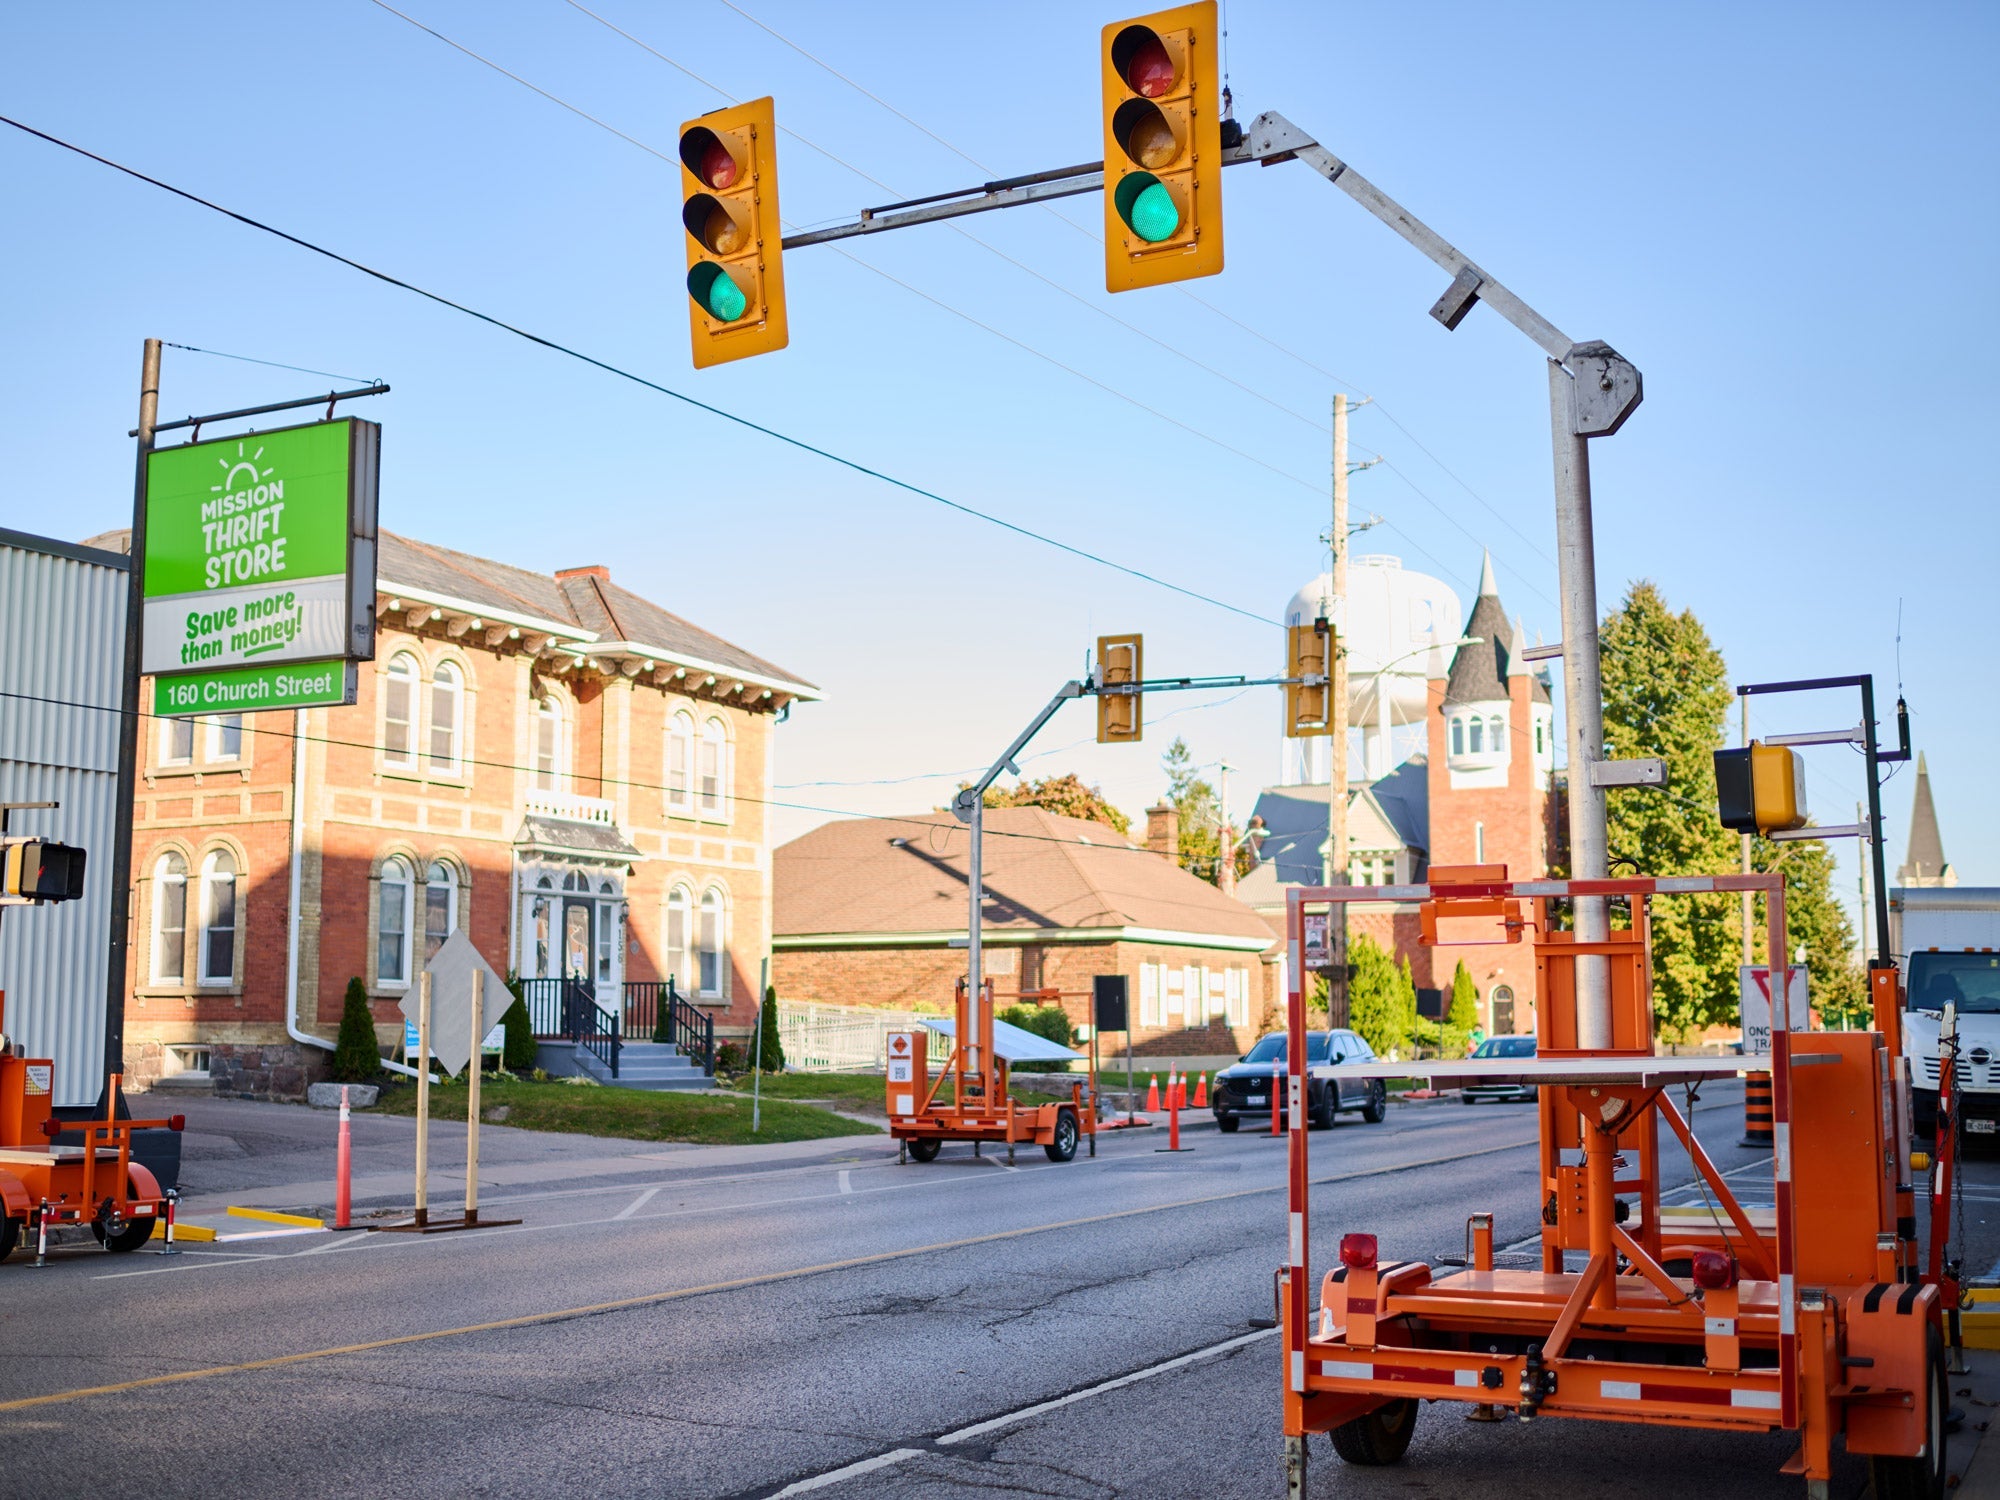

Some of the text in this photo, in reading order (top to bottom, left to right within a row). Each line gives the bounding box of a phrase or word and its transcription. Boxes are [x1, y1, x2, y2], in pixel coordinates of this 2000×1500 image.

[202, 480, 284, 522] MISSION
[202, 502, 285, 554] THRIFT
[205, 537, 287, 588] STORE
[181, 606, 303, 665] than money!
[186, 591, 295, 640] Save more
[168, 672, 332, 706] 160 Church Street
